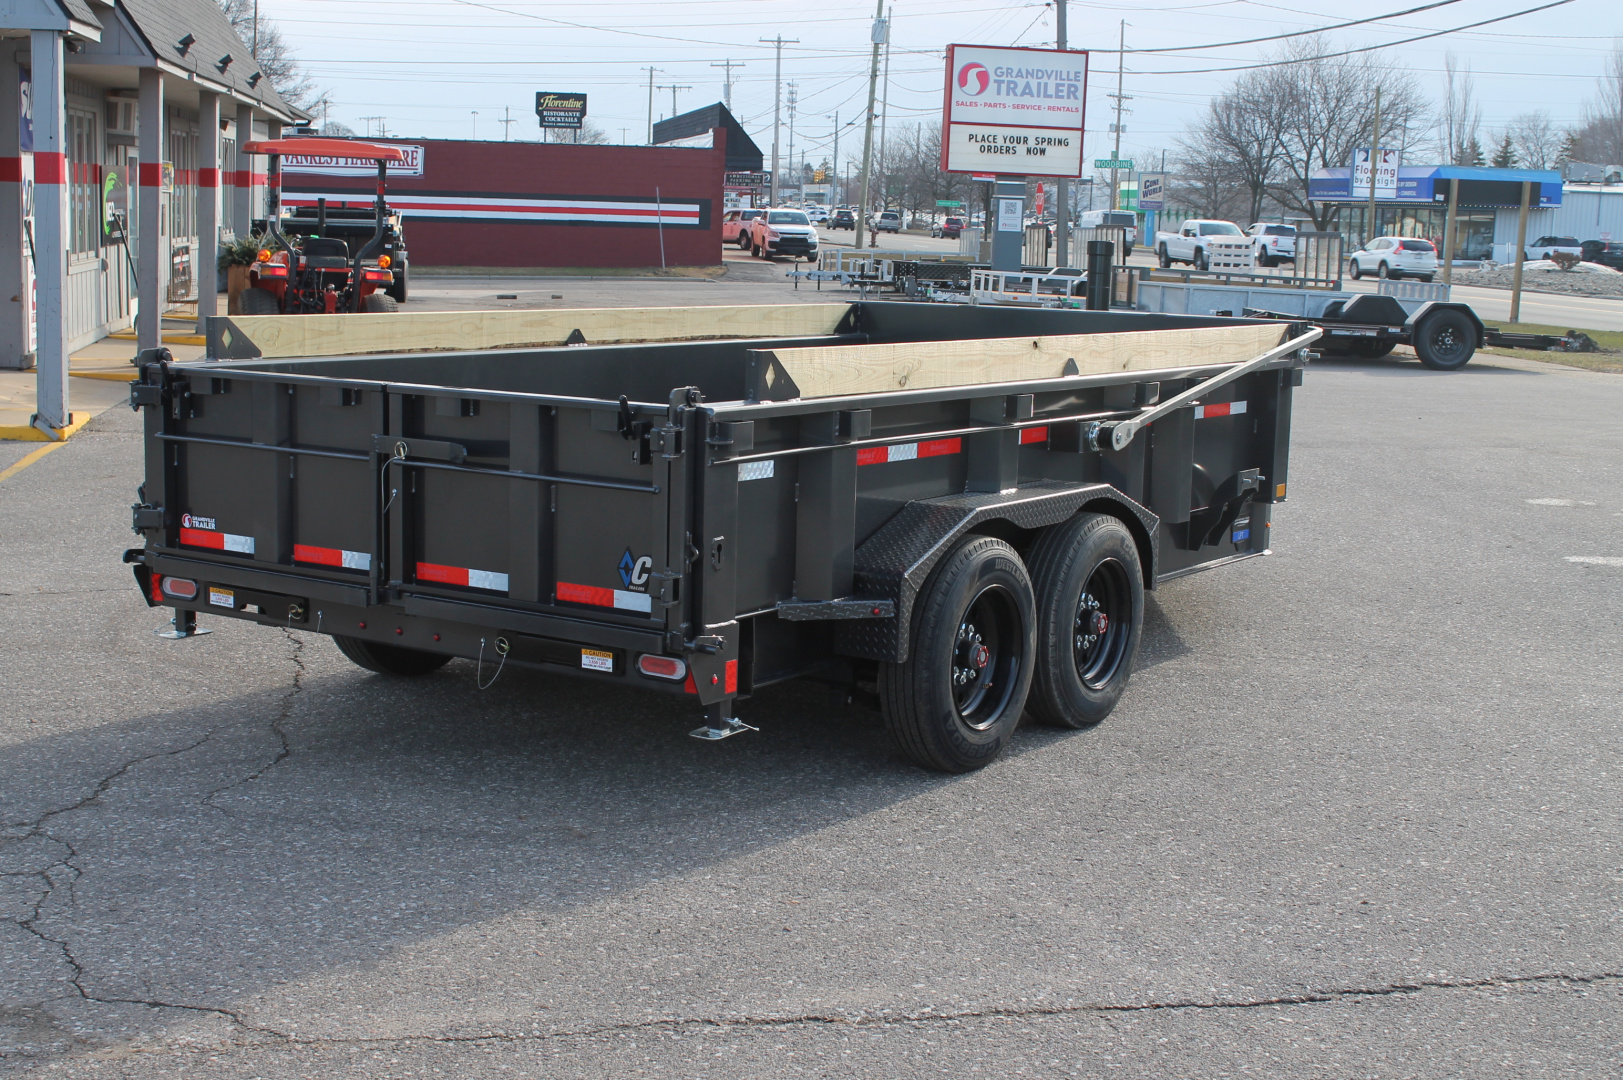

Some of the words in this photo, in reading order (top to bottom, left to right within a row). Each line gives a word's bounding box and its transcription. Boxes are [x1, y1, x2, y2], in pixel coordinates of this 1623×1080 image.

[993, 66, 1082, 82] GRANDVILLE
[993, 79, 1080, 101] TRAILER
[539, 94, 584, 110] Florentine
[955, 100, 979, 108] SALES
[1047, 105, 1080, 113] RENTALS
[968, 133, 998, 144] PLACE
[1002, 135, 1029, 145] YOUR
[1034, 136, 1070, 147] SPRING
[979, 144, 1017, 154] ORDERS
[1026, 147, 1047, 156] NOW
[1095, 160, 1132, 168] WOODBINE
[1354, 176, 1364, 184] by
[1366, 176, 1395, 186] Dsign
[1142, 186, 1162, 198] WORLD
[192, 520, 216, 530] TRAILER
